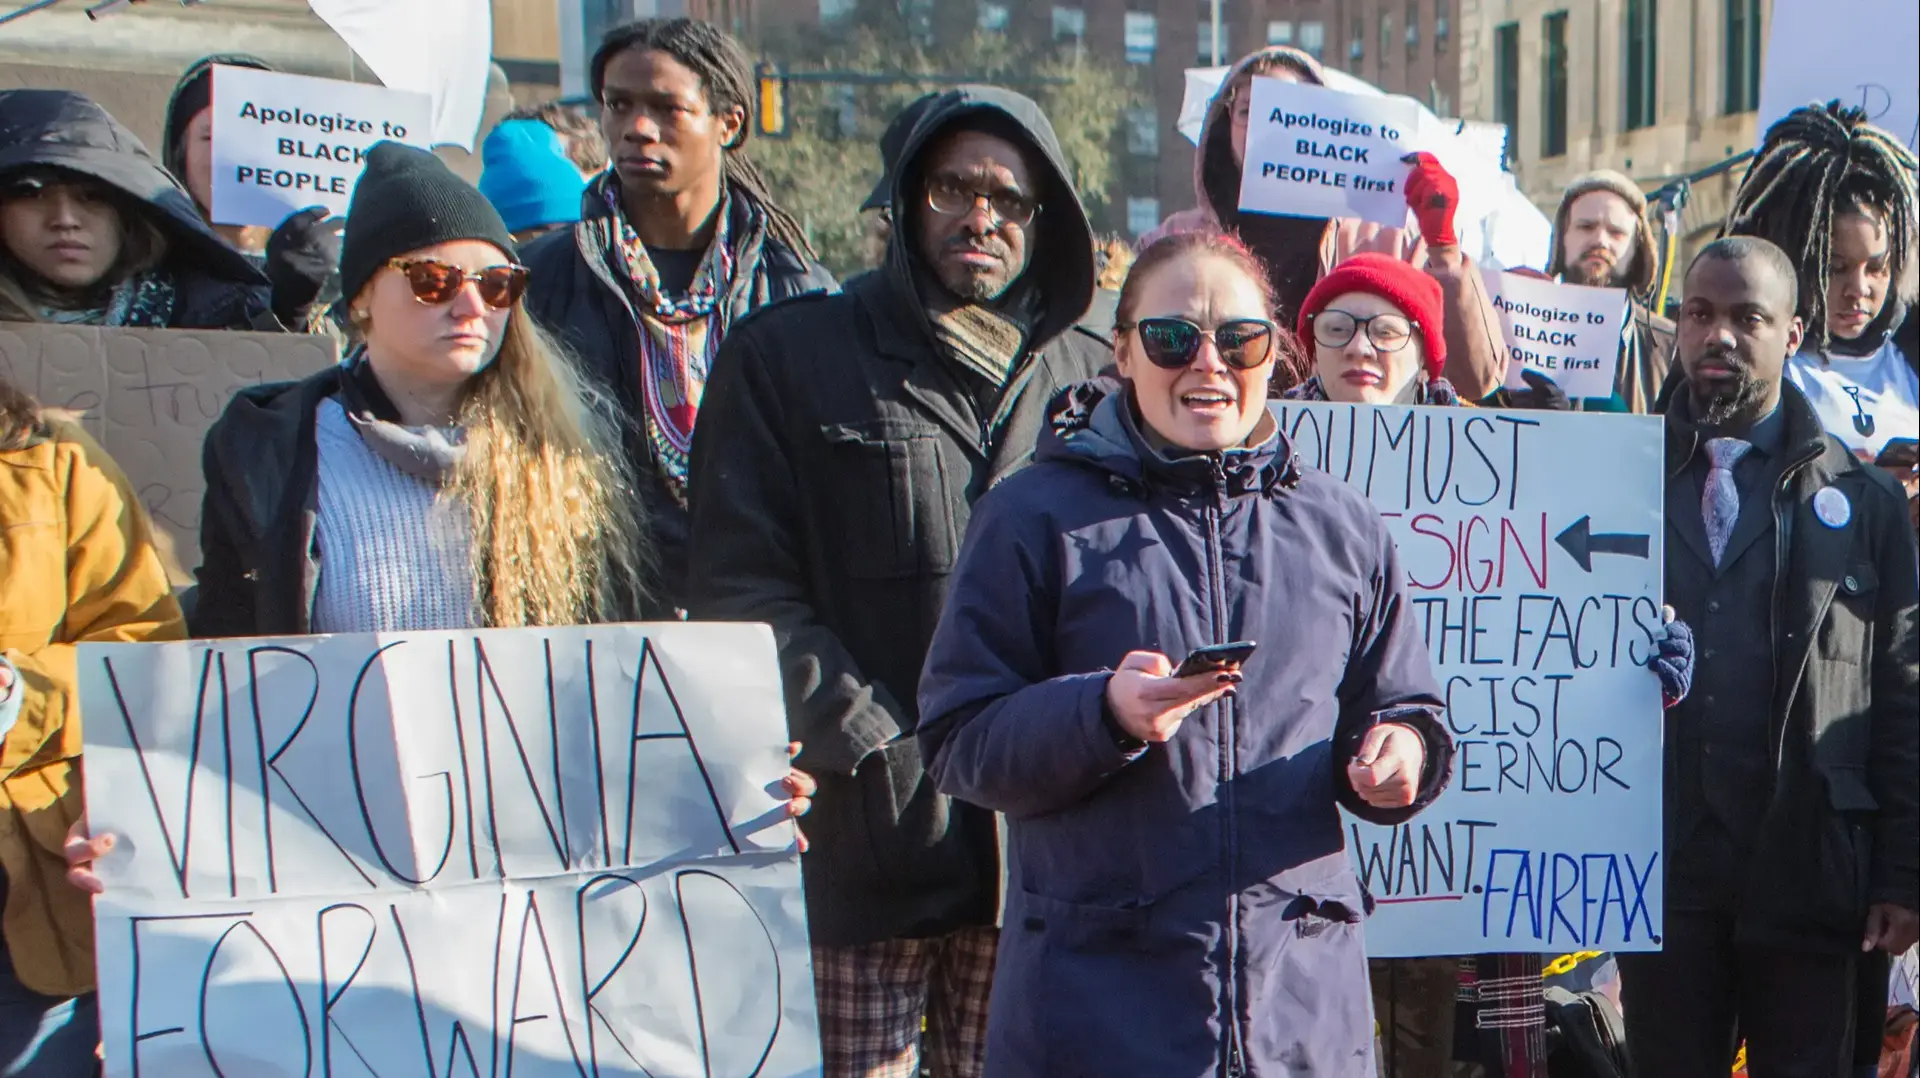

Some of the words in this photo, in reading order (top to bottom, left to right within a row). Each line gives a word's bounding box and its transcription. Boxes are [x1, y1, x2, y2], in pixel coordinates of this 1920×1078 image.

[239, 101, 373, 133] Apologize
[381, 120, 407, 138] to
[1269, 107, 1373, 136] Apologize
[1380, 124, 1400, 140] to
[1296, 139, 1369, 164] BLACK
[236, 165, 347, 195] PEOPLE
[1262, 161, 1347, 188] PEOPLE
[1353, 175, 1396, 193] first
[1493, 295, 1580, 323] Apologize
[1586, 311, 1605, 325] to
[1513, 324, 1577, 347] BLACK
[1506, 345, 1557, 370] OPLE
[1563, 356, 1600, 370] first
[1366, 408, 1541, 511] MUST
[1380, 511, 1547, 593] SIGN
[1412, 595, 1503, 665] THE
[1512, 594, 1658, 671] FACTS
[103, 636, 742, 899] VIRGINIA
[130, 869, 782, 1078] FORWARD
